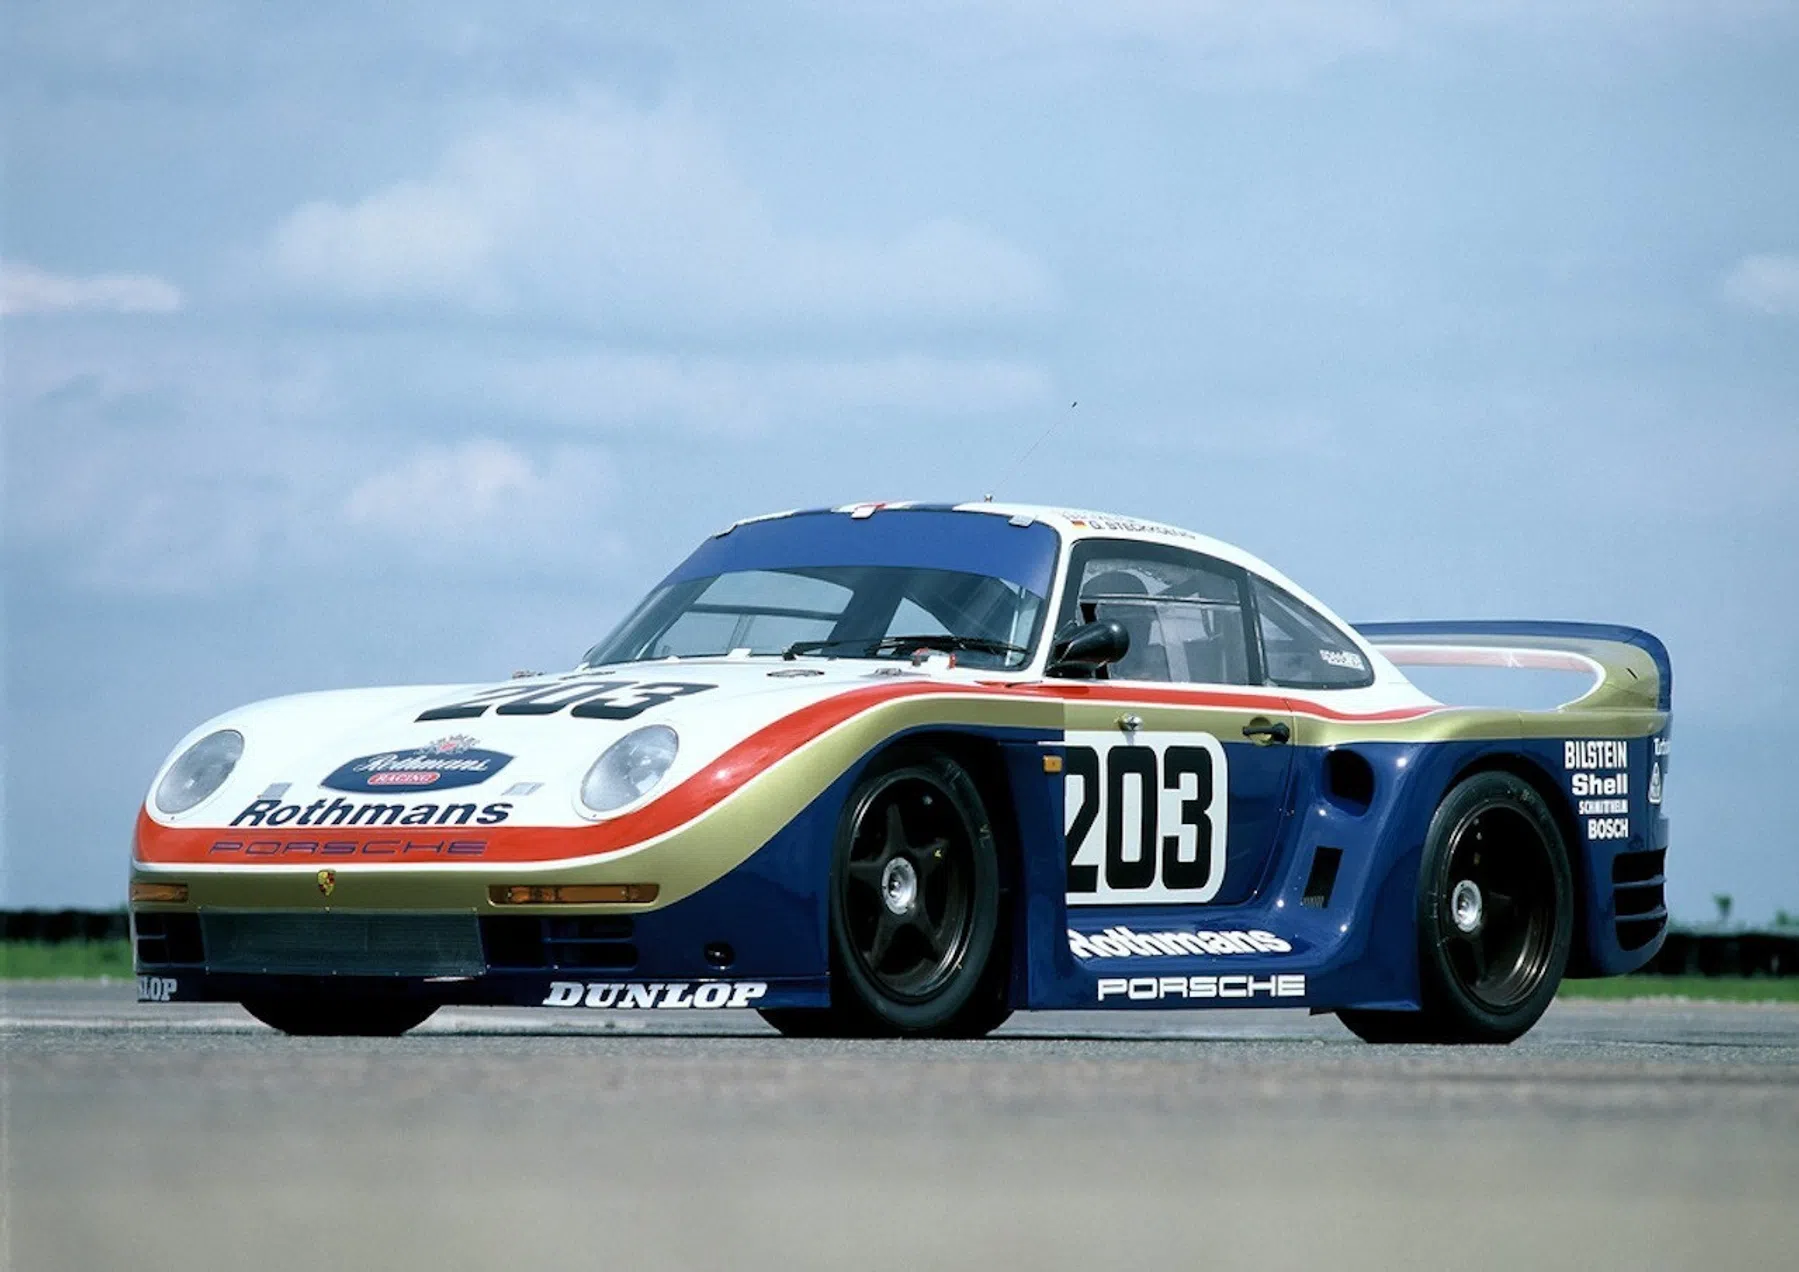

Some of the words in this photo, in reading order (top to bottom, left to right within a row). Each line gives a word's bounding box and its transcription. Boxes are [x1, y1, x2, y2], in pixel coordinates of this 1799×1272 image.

[413, 680, 720, 723] 203
[353, 752, 491, 773] Rothmans
[1564, 740, 1628, 770] BILSTEIN
[374, 773, 434, 783] RACING
[1571, 772, 1629, 796] Shell
[228, 796, 514, 827] Rothmans
[1065, 745, 1213, 893] 203
[1588, 818, 1629, 840] BOSCH
[208, 840, 489, 856] PORSCHE
[542, 981, 768, 1009] DUNLOP
[1098, 974, 1306, 1001] PORSCHE
